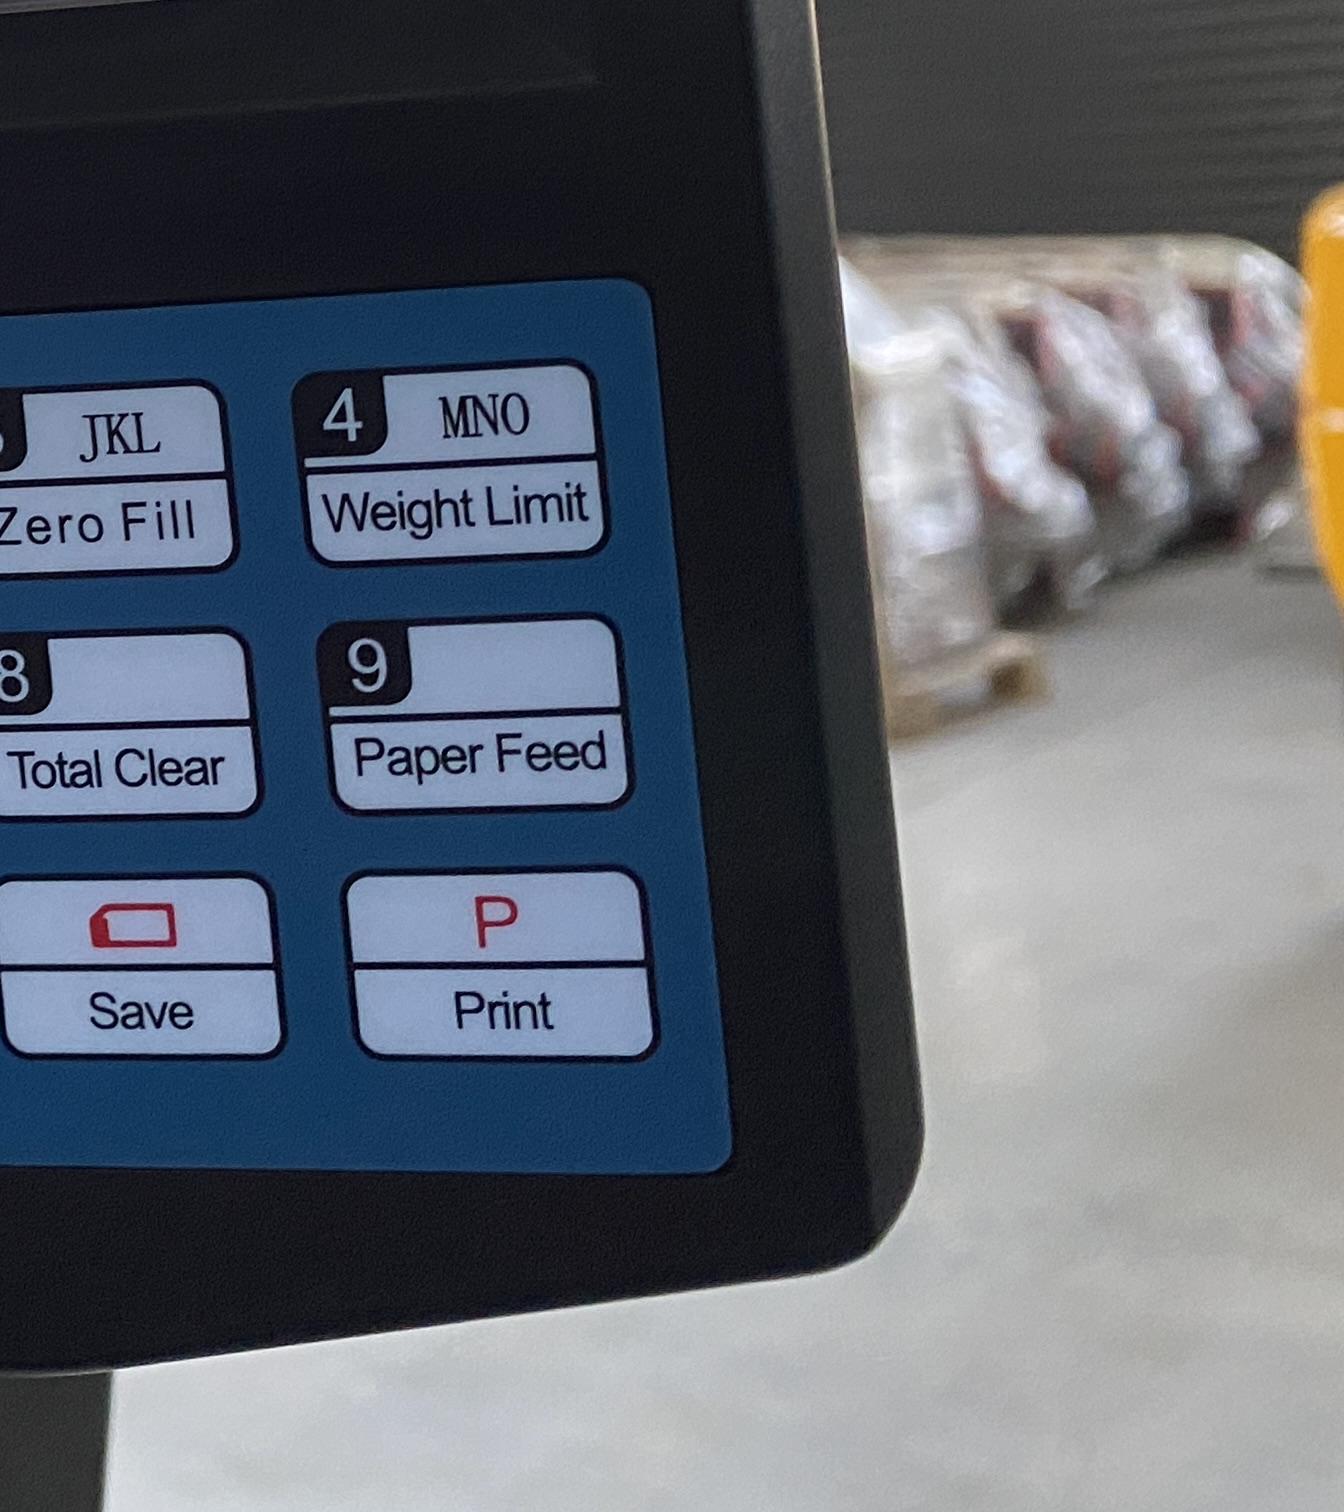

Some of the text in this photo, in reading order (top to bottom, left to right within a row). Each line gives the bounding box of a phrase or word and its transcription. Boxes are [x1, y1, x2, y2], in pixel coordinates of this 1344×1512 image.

[79, 411, 162, 464] JKL
[321, 387, 364, 442] 4
[438, 392, 530, 440] MNO
[121, 499, 195, 543] Fill
[321, 481, 591, 541] Weight Limit
[346, 636, 389, 693] 9
[8, 744, 225, 791] Total Clear
[354, 729, 607, 785] Paper Feed
[475, 894, 518, 948] P
[88, 991, 195, 1031] Save
[454, 989, 555, 1031] Print
